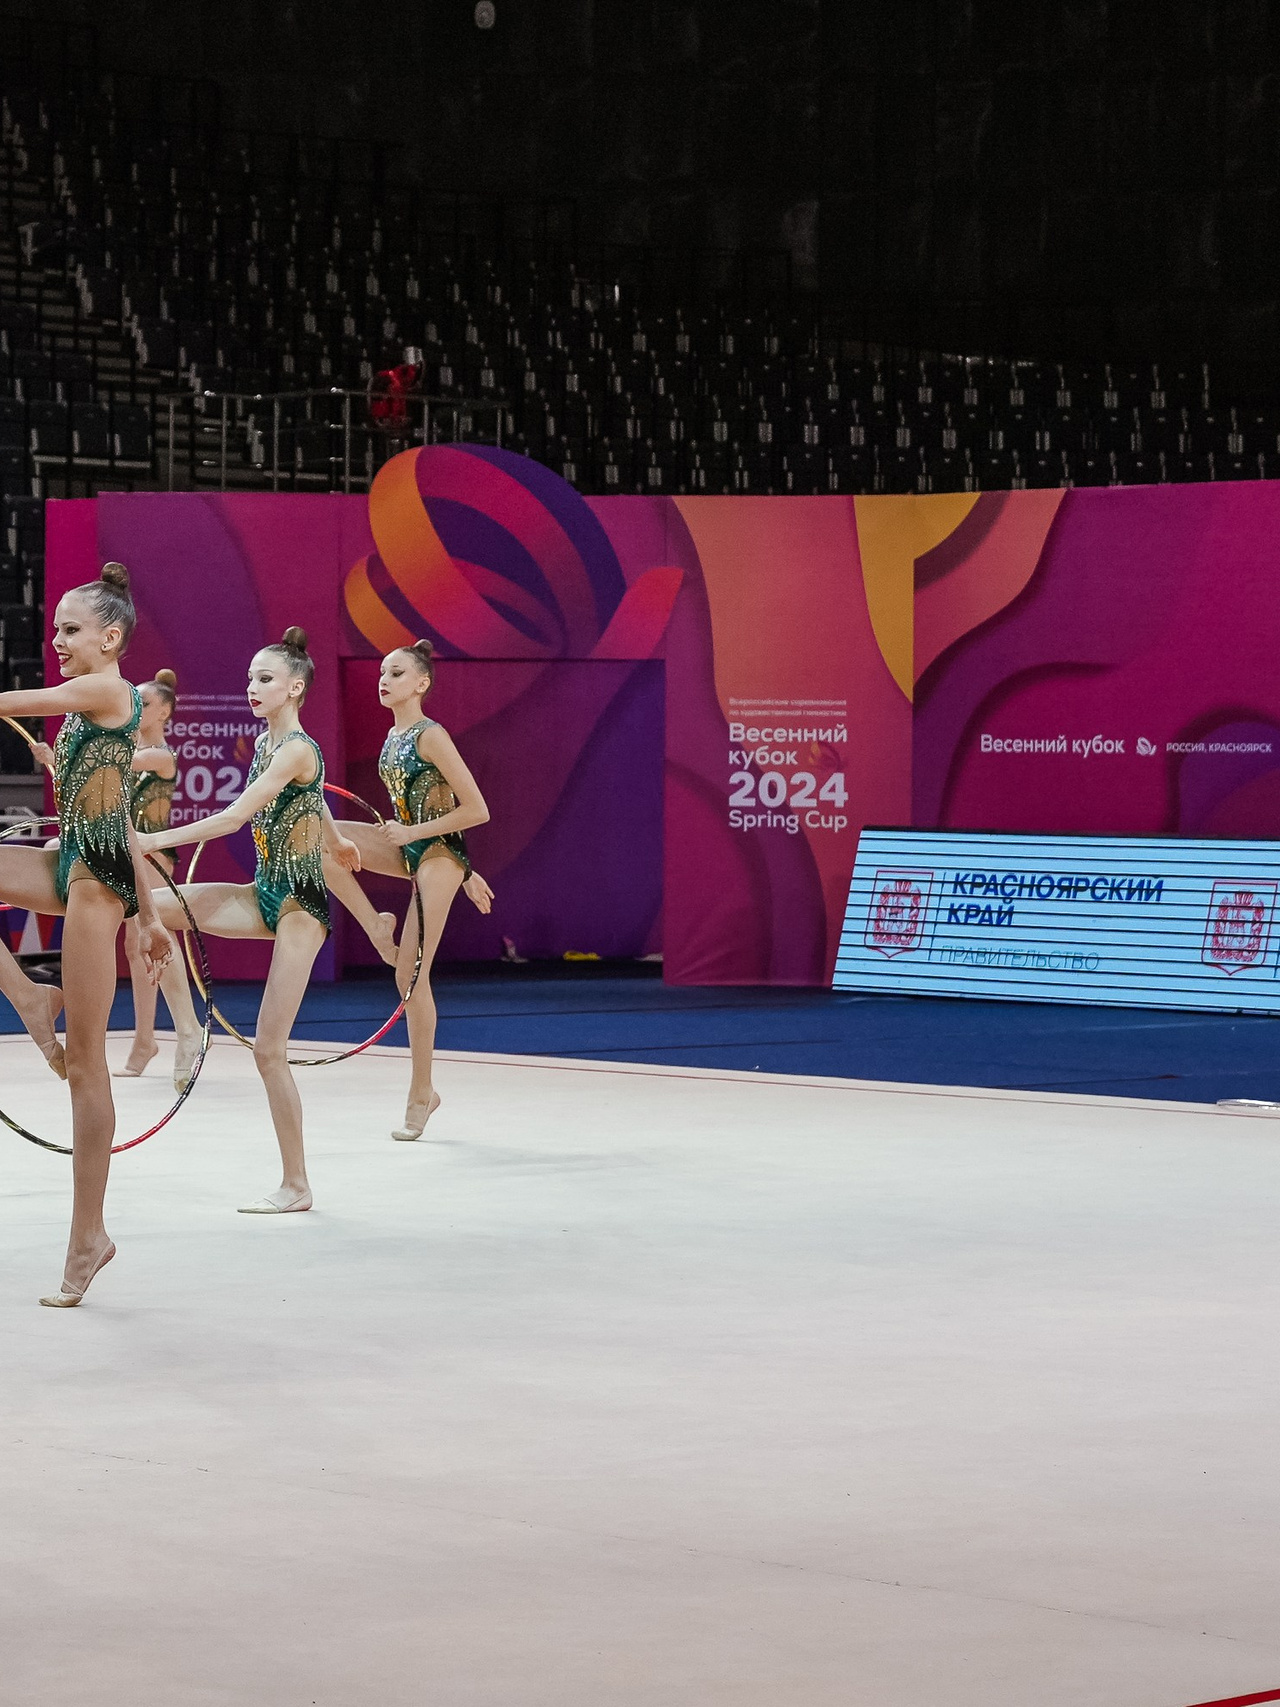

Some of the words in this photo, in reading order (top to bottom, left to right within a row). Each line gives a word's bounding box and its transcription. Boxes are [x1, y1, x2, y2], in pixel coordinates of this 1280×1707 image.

[728, 722, 848, 743] Весенний
[728, 745, 798, 770] кубок
[980, 734, 1068, 753] Весенний
[1072, 734, 1125, 758] кубок
[1209, 743, 1272, 754] КРАСНОЯРСК
[728, 771, 849, 809] 2024
[728, 810, 799, 834] Spring
[805, 811, 848, 833] Cup
[952, 872, 1164, 903] КРАСНОЯРСКИЙ
[947, 899, 1015, 926] КРАЙ
[940, 944, 1100, 971] ПРАВИТЕЛЬСТВО
